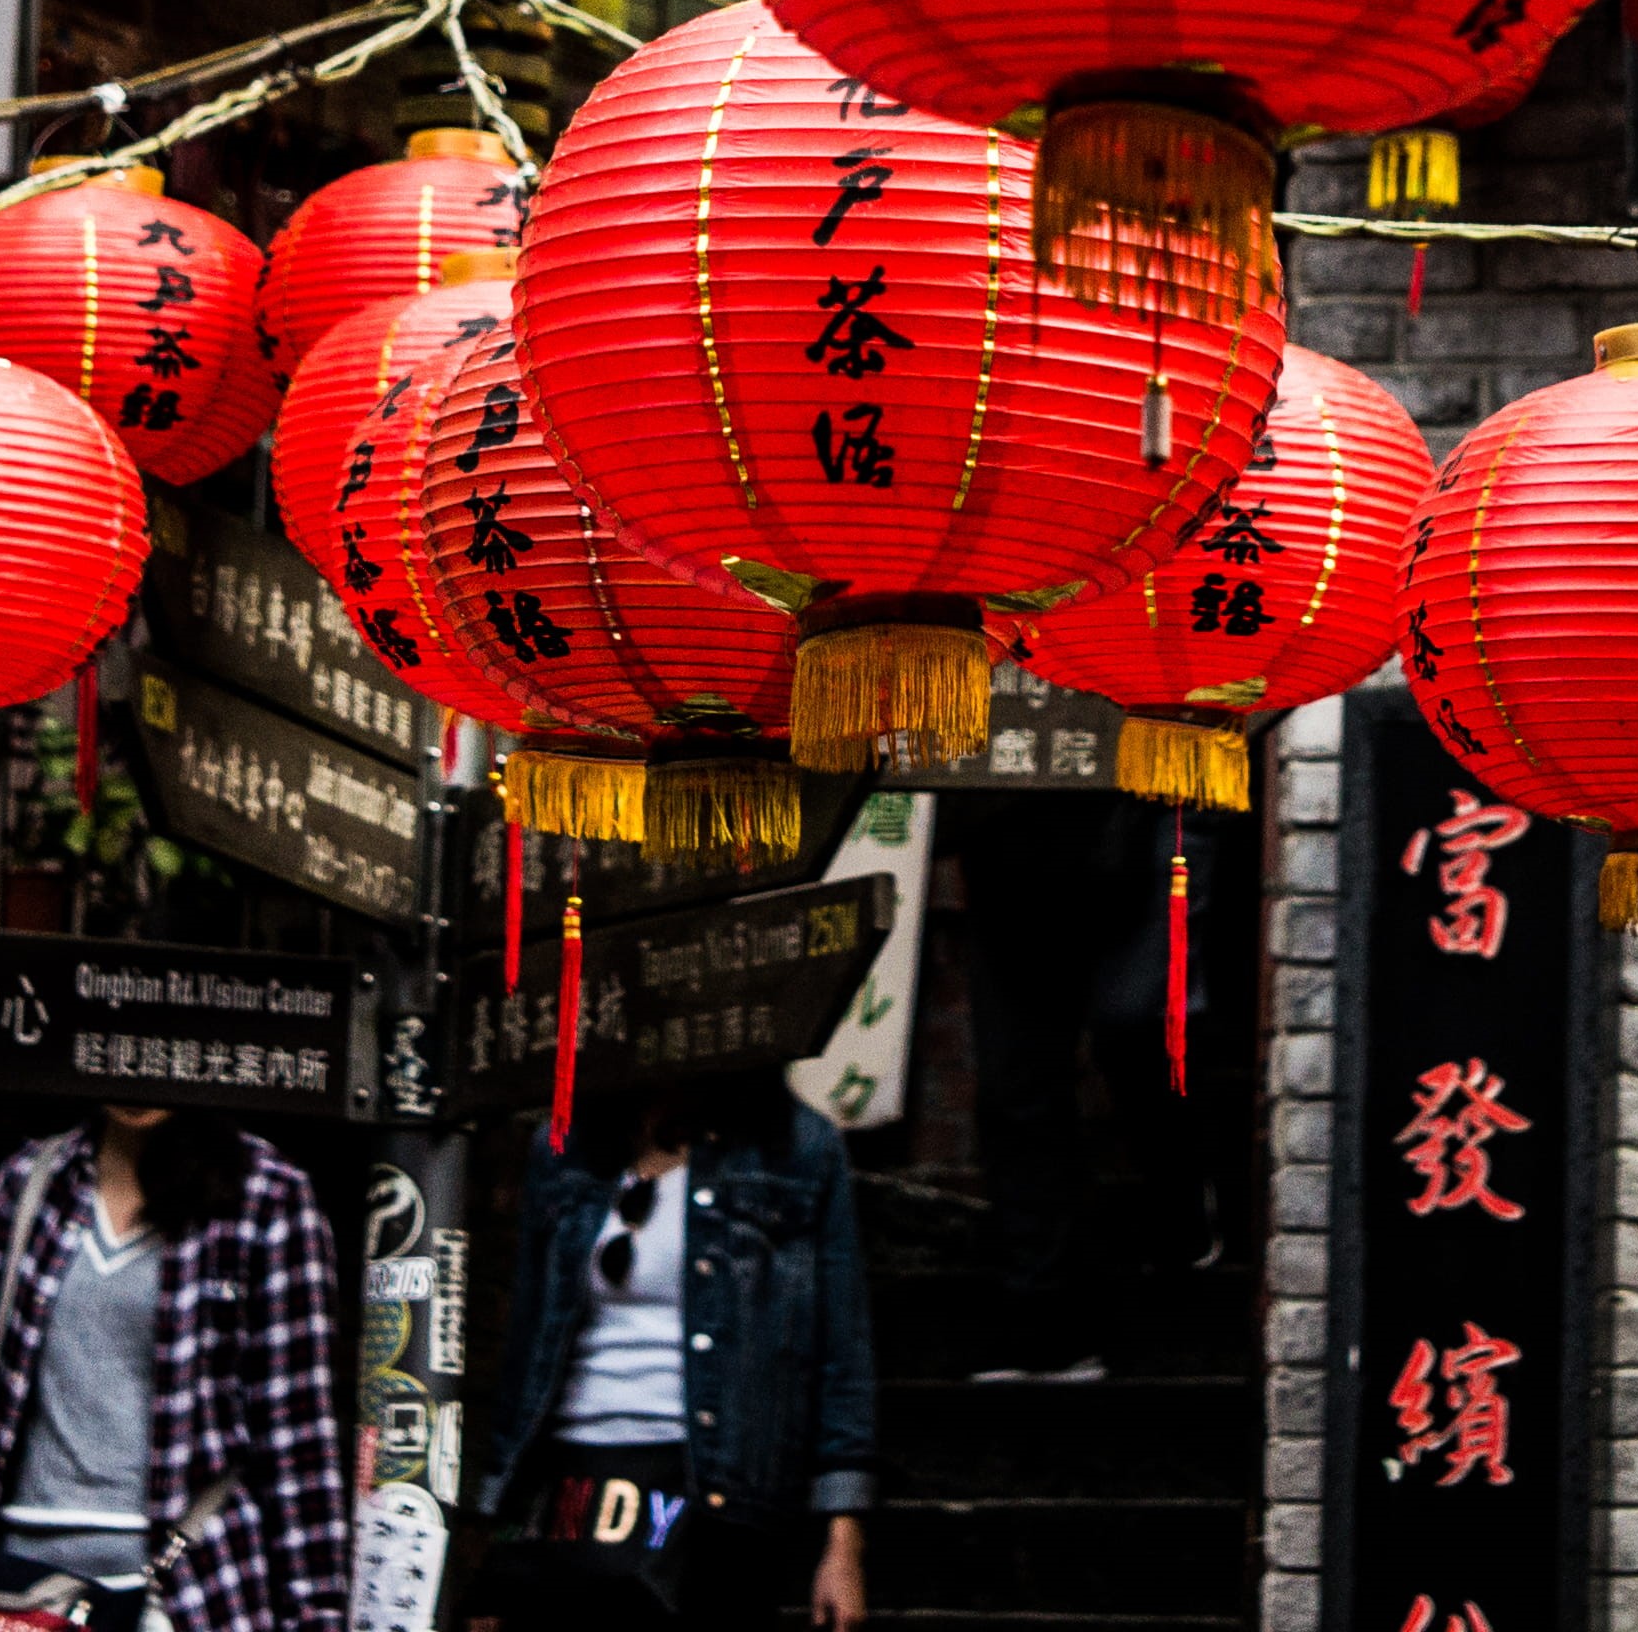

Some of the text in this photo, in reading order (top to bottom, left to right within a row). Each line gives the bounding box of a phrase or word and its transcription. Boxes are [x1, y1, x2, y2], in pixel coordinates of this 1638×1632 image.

[266, 976, 334, 1018] Center
[1393, 788, 1532, 1632] 富發繽
